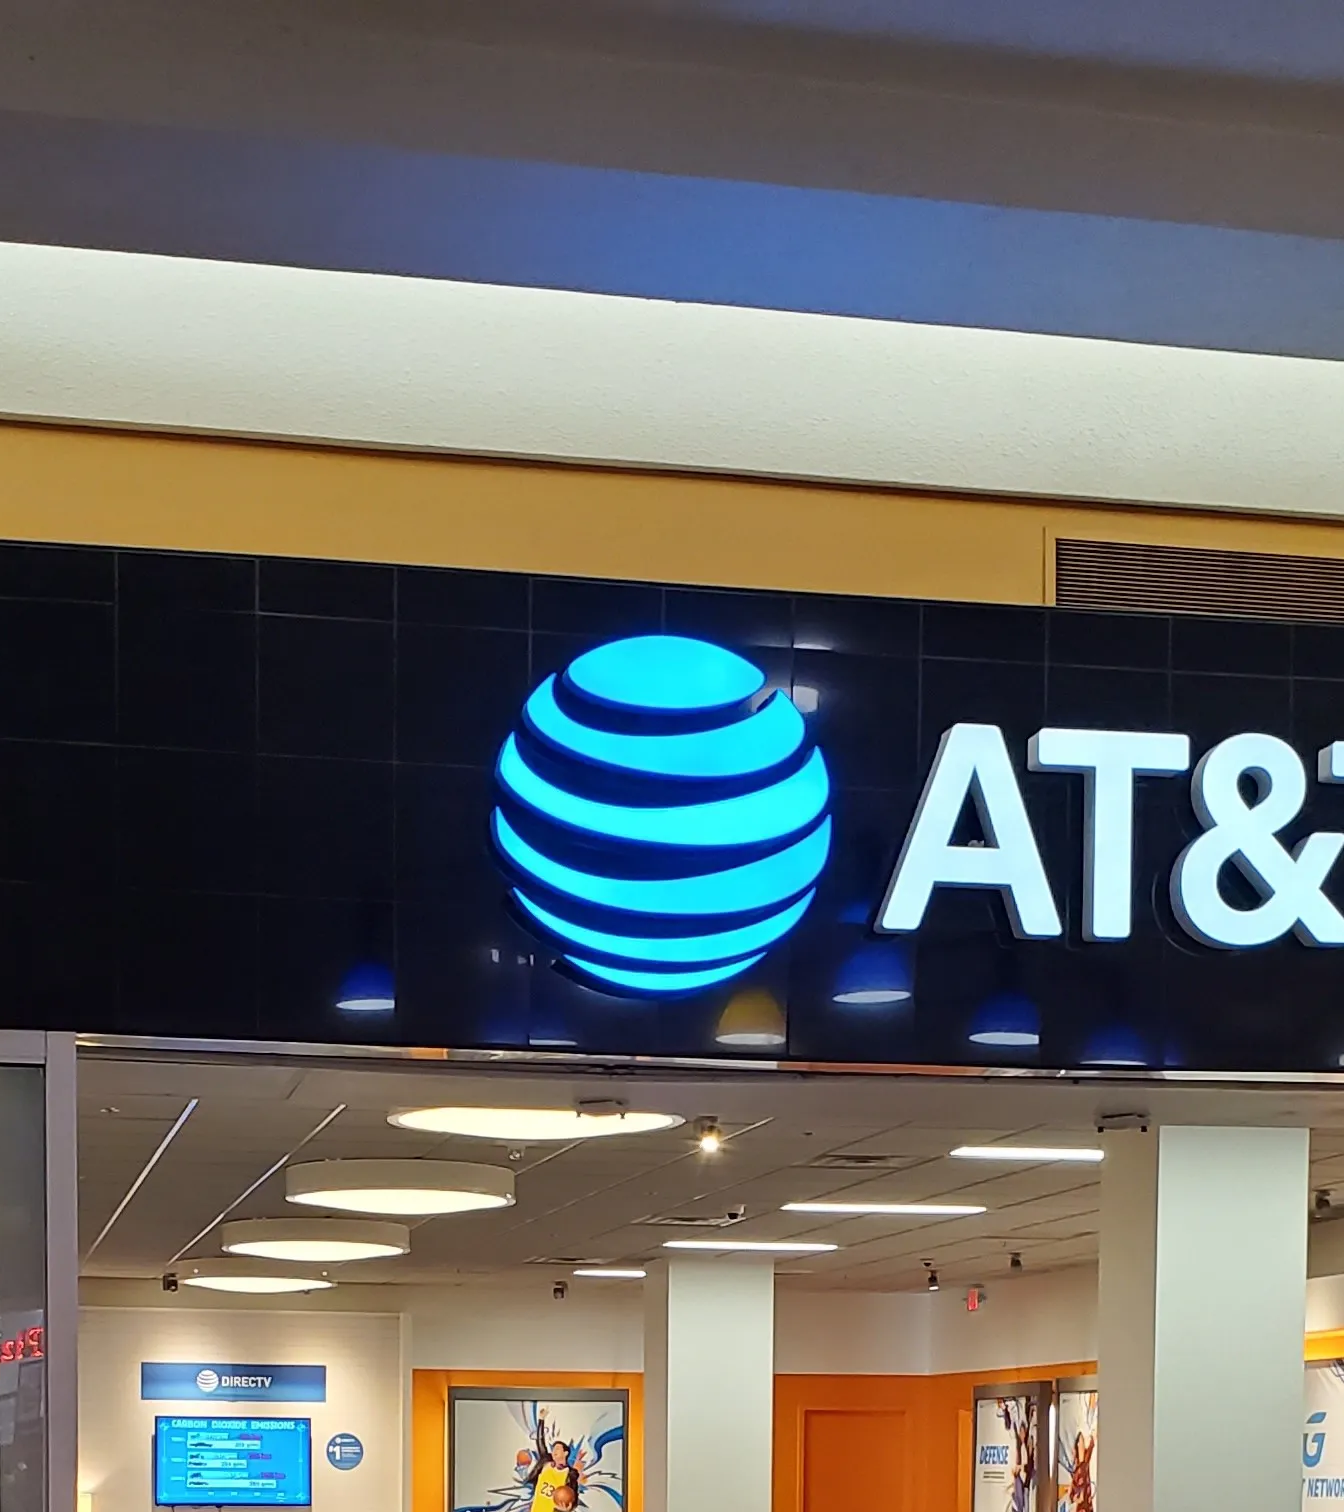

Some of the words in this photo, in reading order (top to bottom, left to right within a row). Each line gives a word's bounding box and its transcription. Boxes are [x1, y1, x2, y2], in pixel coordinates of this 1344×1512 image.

[221, 1376, 272, 1389] DIRECTV
[171, 1420, 207, 1429] CARBON
[211, 1420, 247, 1429] DIOXIDE
[251, 1421, 295, 1430] EMISSIONS
[979, 1445, 1009, 1465] DEFENSE
[541, 1482, 555, 1497] 23
